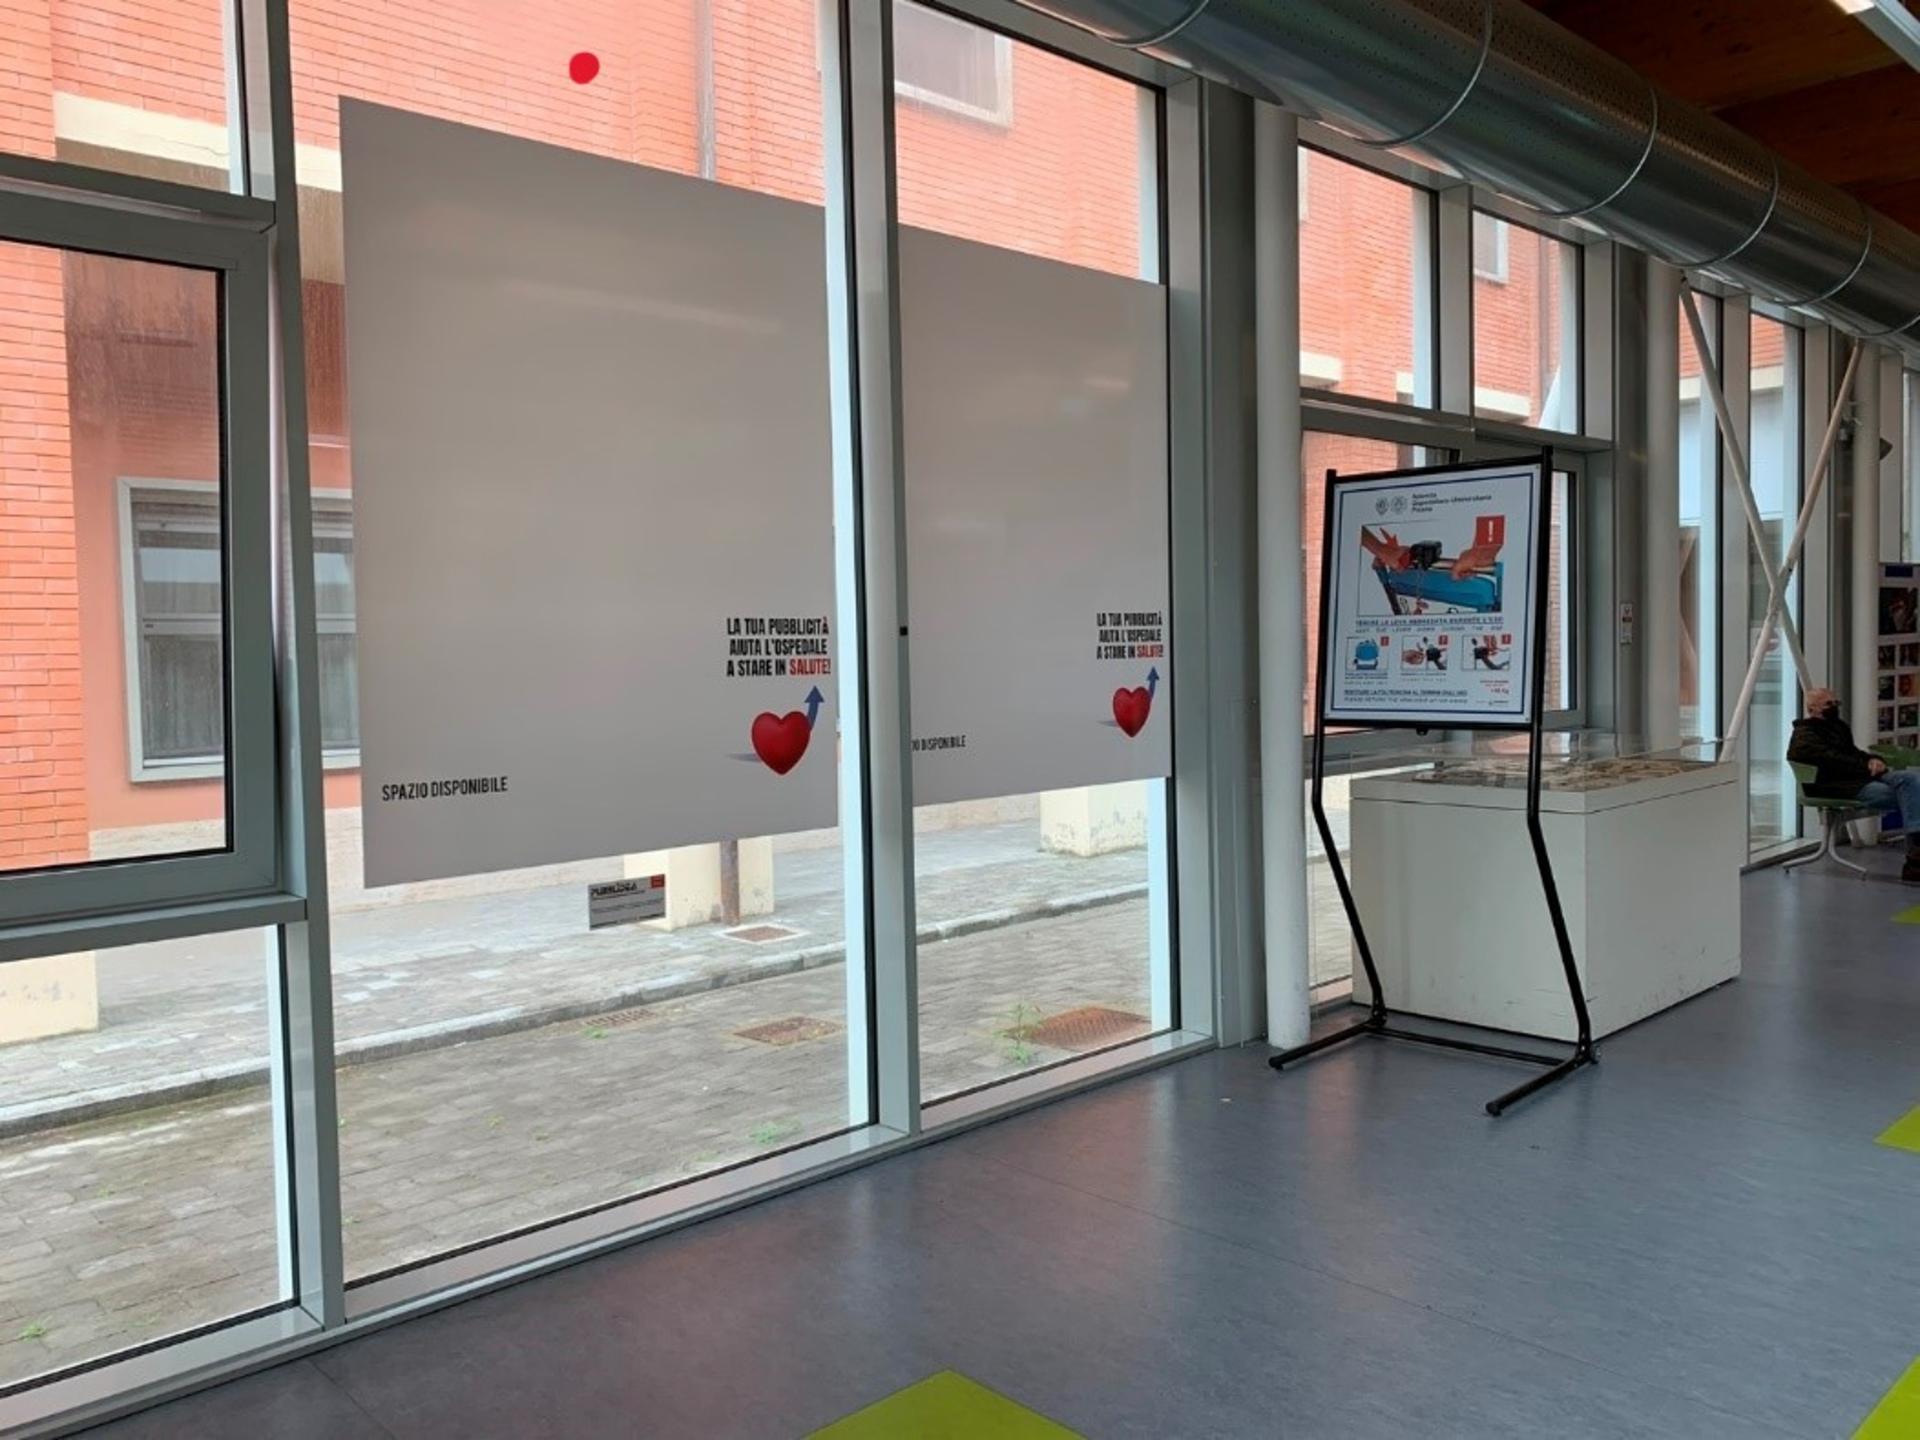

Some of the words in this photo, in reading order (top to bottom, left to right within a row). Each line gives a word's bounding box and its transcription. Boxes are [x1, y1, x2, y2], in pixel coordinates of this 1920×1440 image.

[726, 617, 741, 635] LA
[744, 618, 766, 635] TUA
[768, 616, 829, 635] PUBBLICITÀ
[1096, 612, 1106, 627] LA
[1108, 612, 1121, 627] TUA
[729, 638, 762, 656] AIUTA
[765, 638, 828, 656] L'OSPEDALE
[726, 659, 735, 677] A
[738, 659, 772, 676] STARE
[775, 659, 786, 675] IN
[789, 658, 831, 675] SALUTE!
[382, 782, 428, 802] SPAZIO
[430, 776, 508, 798] DISPONIBILE
